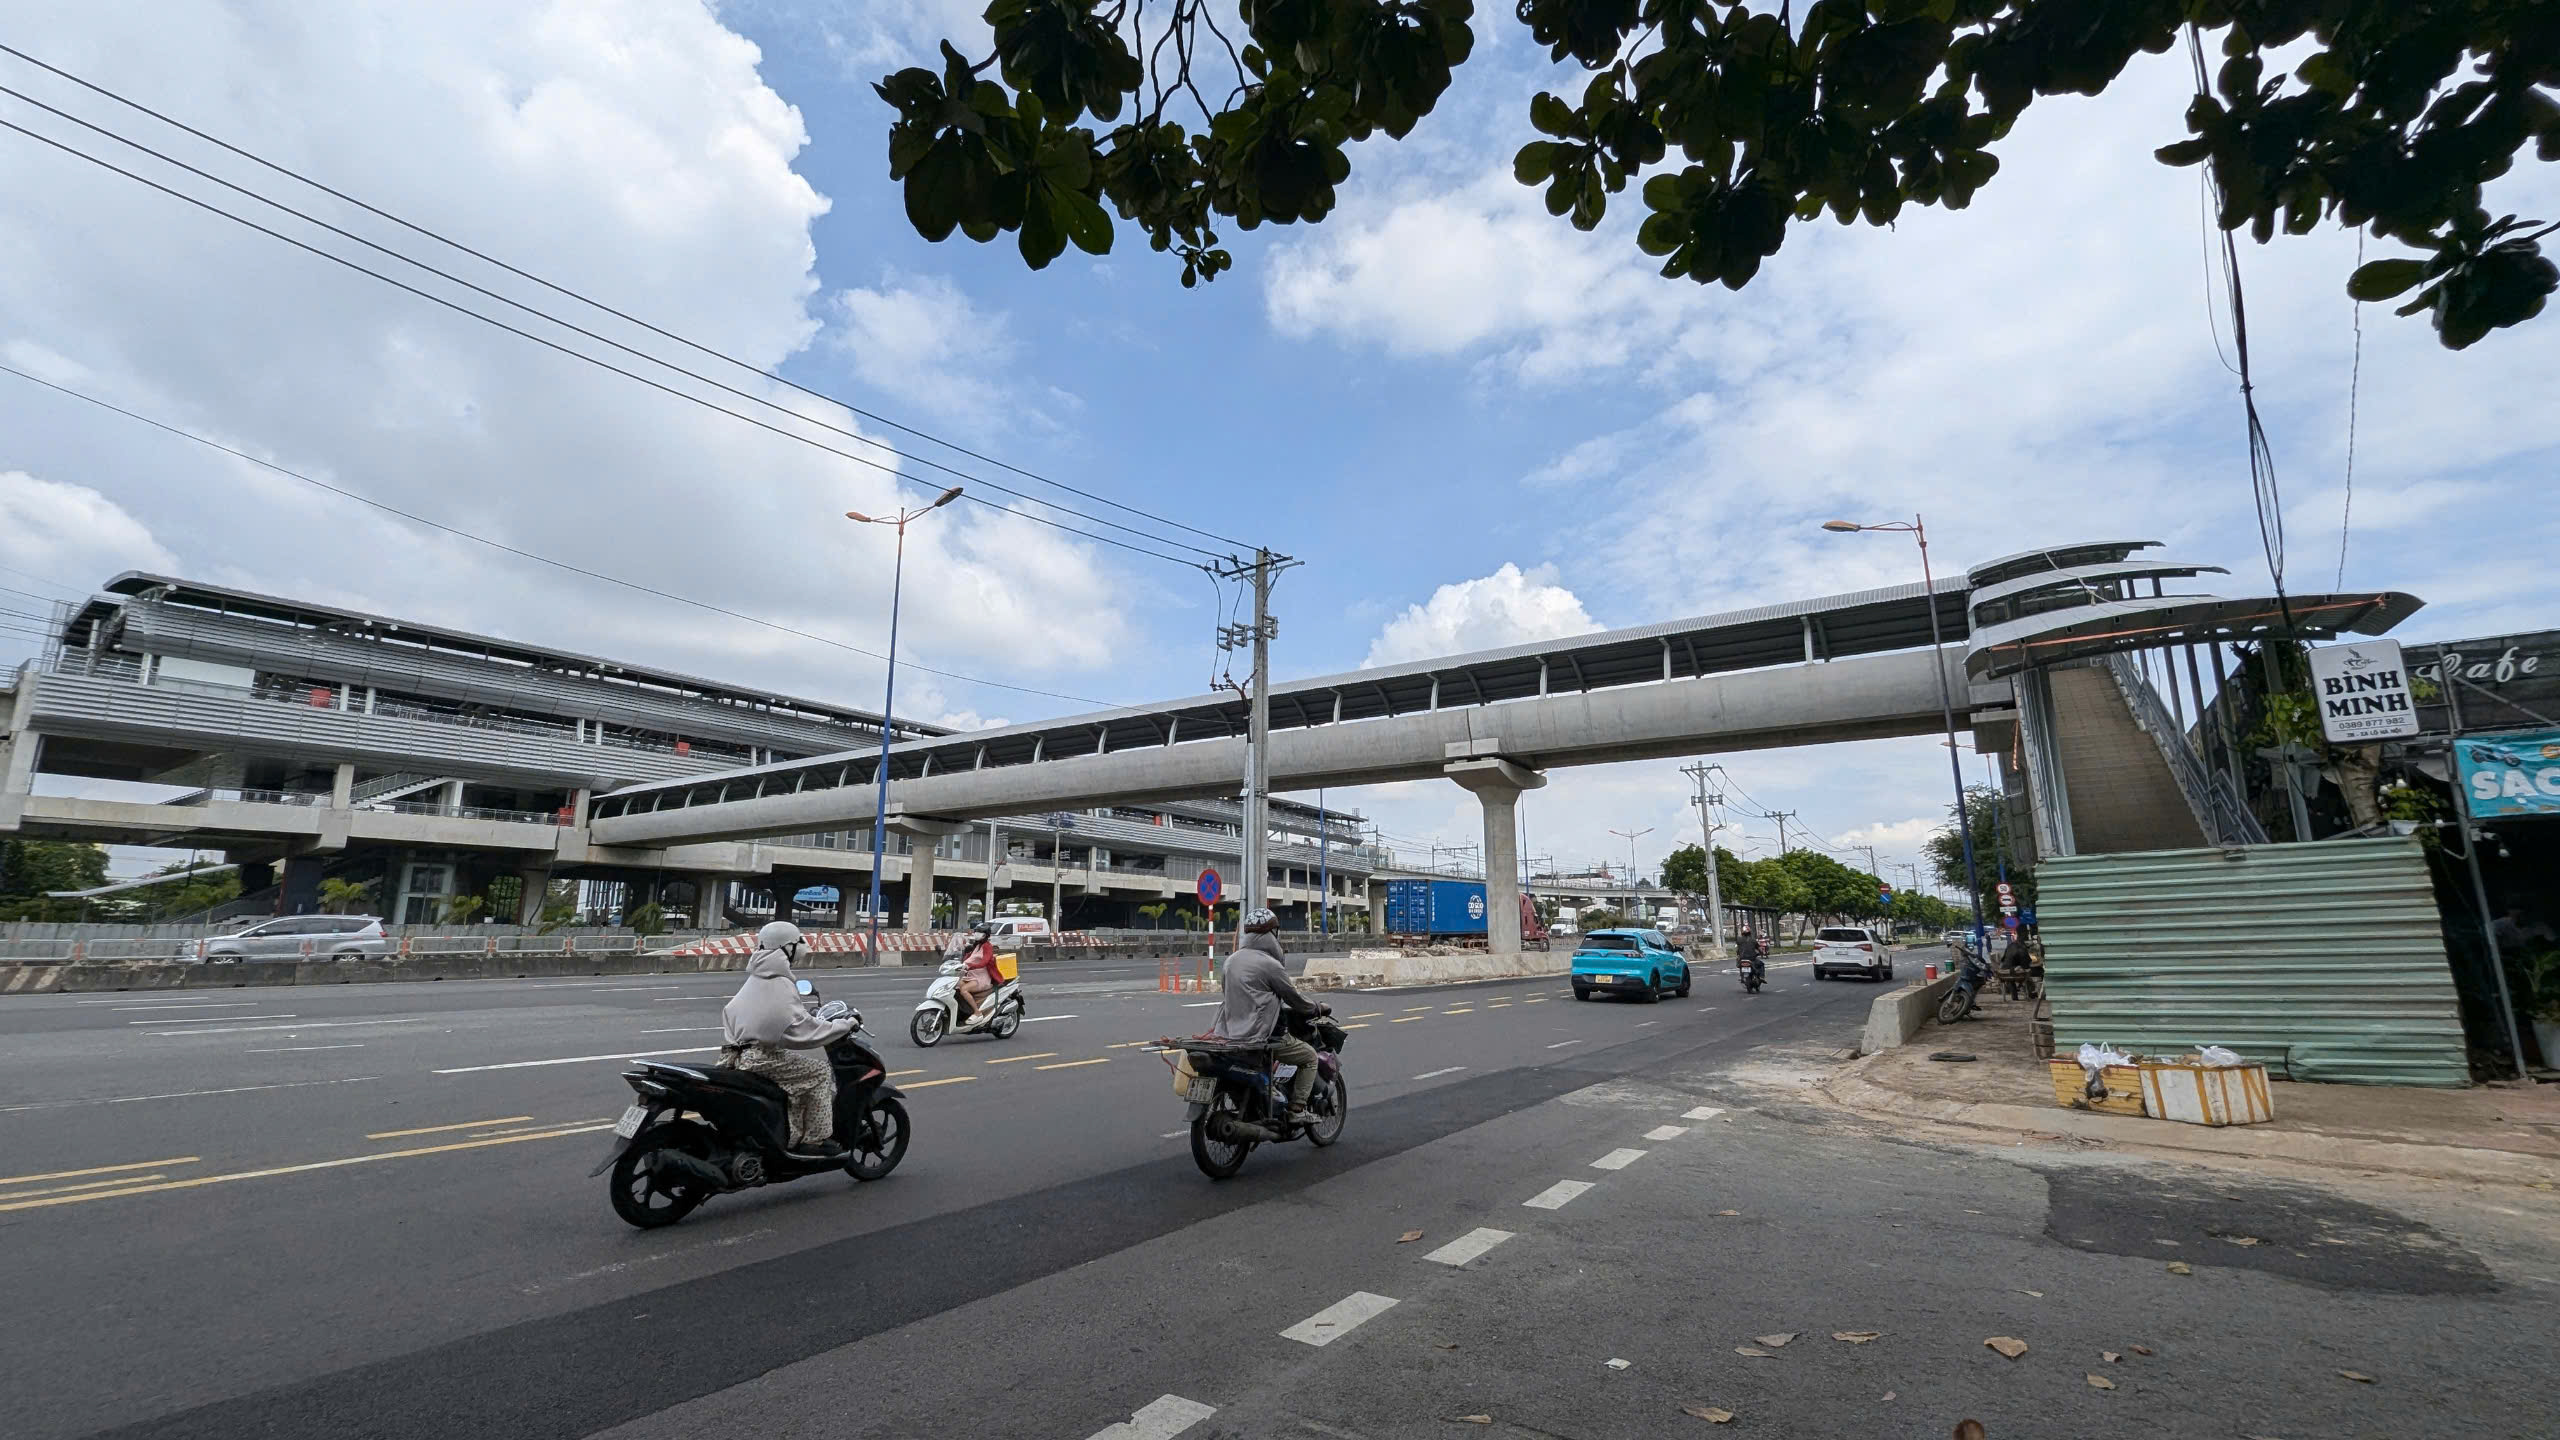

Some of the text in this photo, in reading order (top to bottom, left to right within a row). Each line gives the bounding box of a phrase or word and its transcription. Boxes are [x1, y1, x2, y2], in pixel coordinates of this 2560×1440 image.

[2415, 646, 2539, 683] Cafe
[2323, 670, 2401, 695] BÌNH
[2326, 693, 2409, 718] MINH
[2339, 721, 2363, 730] 0389
[2386, 717, 2405, 725] 982
